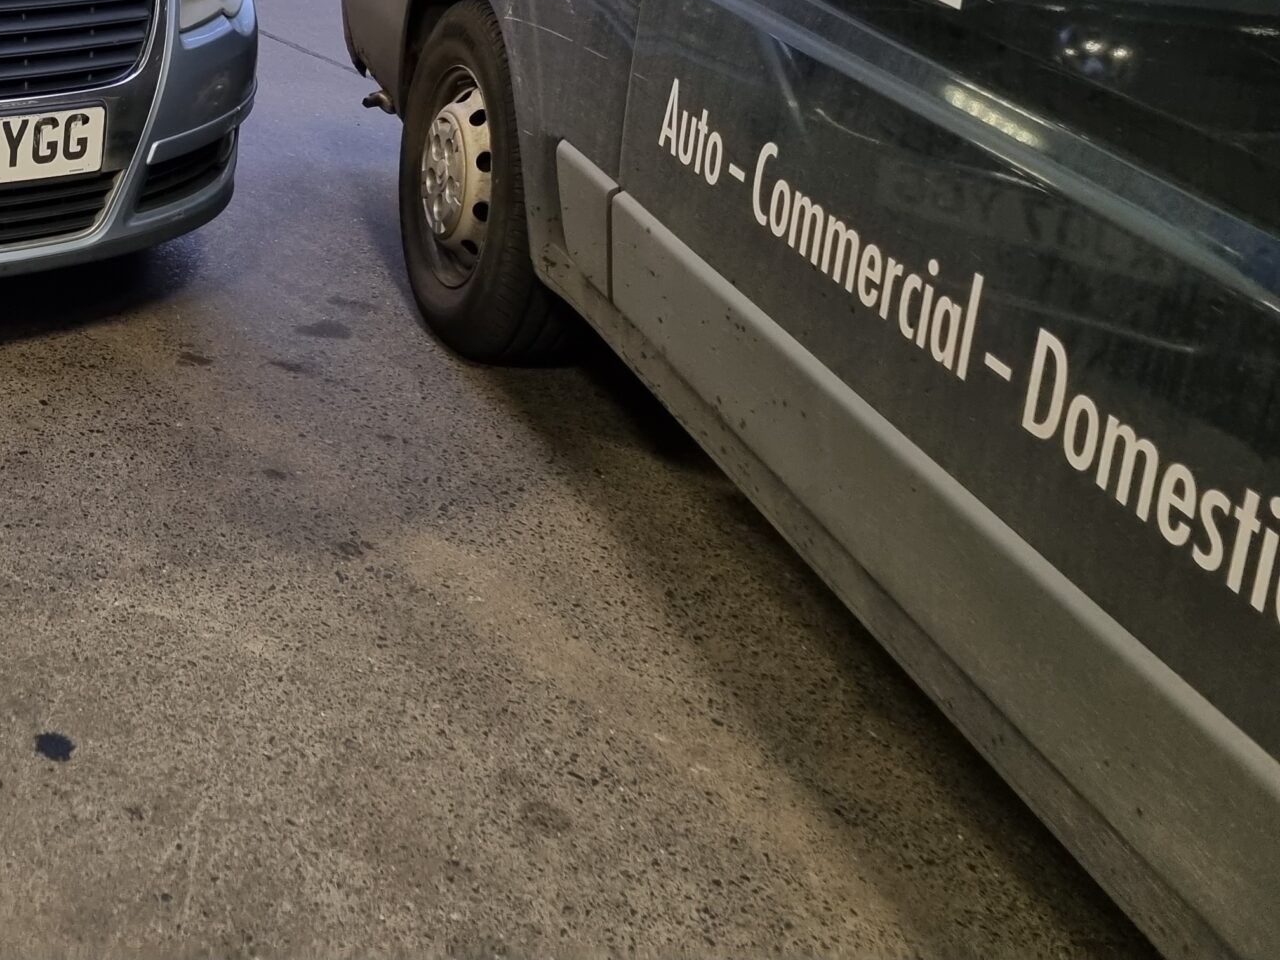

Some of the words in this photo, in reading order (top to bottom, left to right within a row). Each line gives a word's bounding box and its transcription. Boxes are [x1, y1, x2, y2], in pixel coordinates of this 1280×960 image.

[2, 113, 90, 168] YGG
[658, 77, 723, 186] Auto
[752, 141, 985, 382] Commercial
[1021, 327, 1280, 624] Domesti
